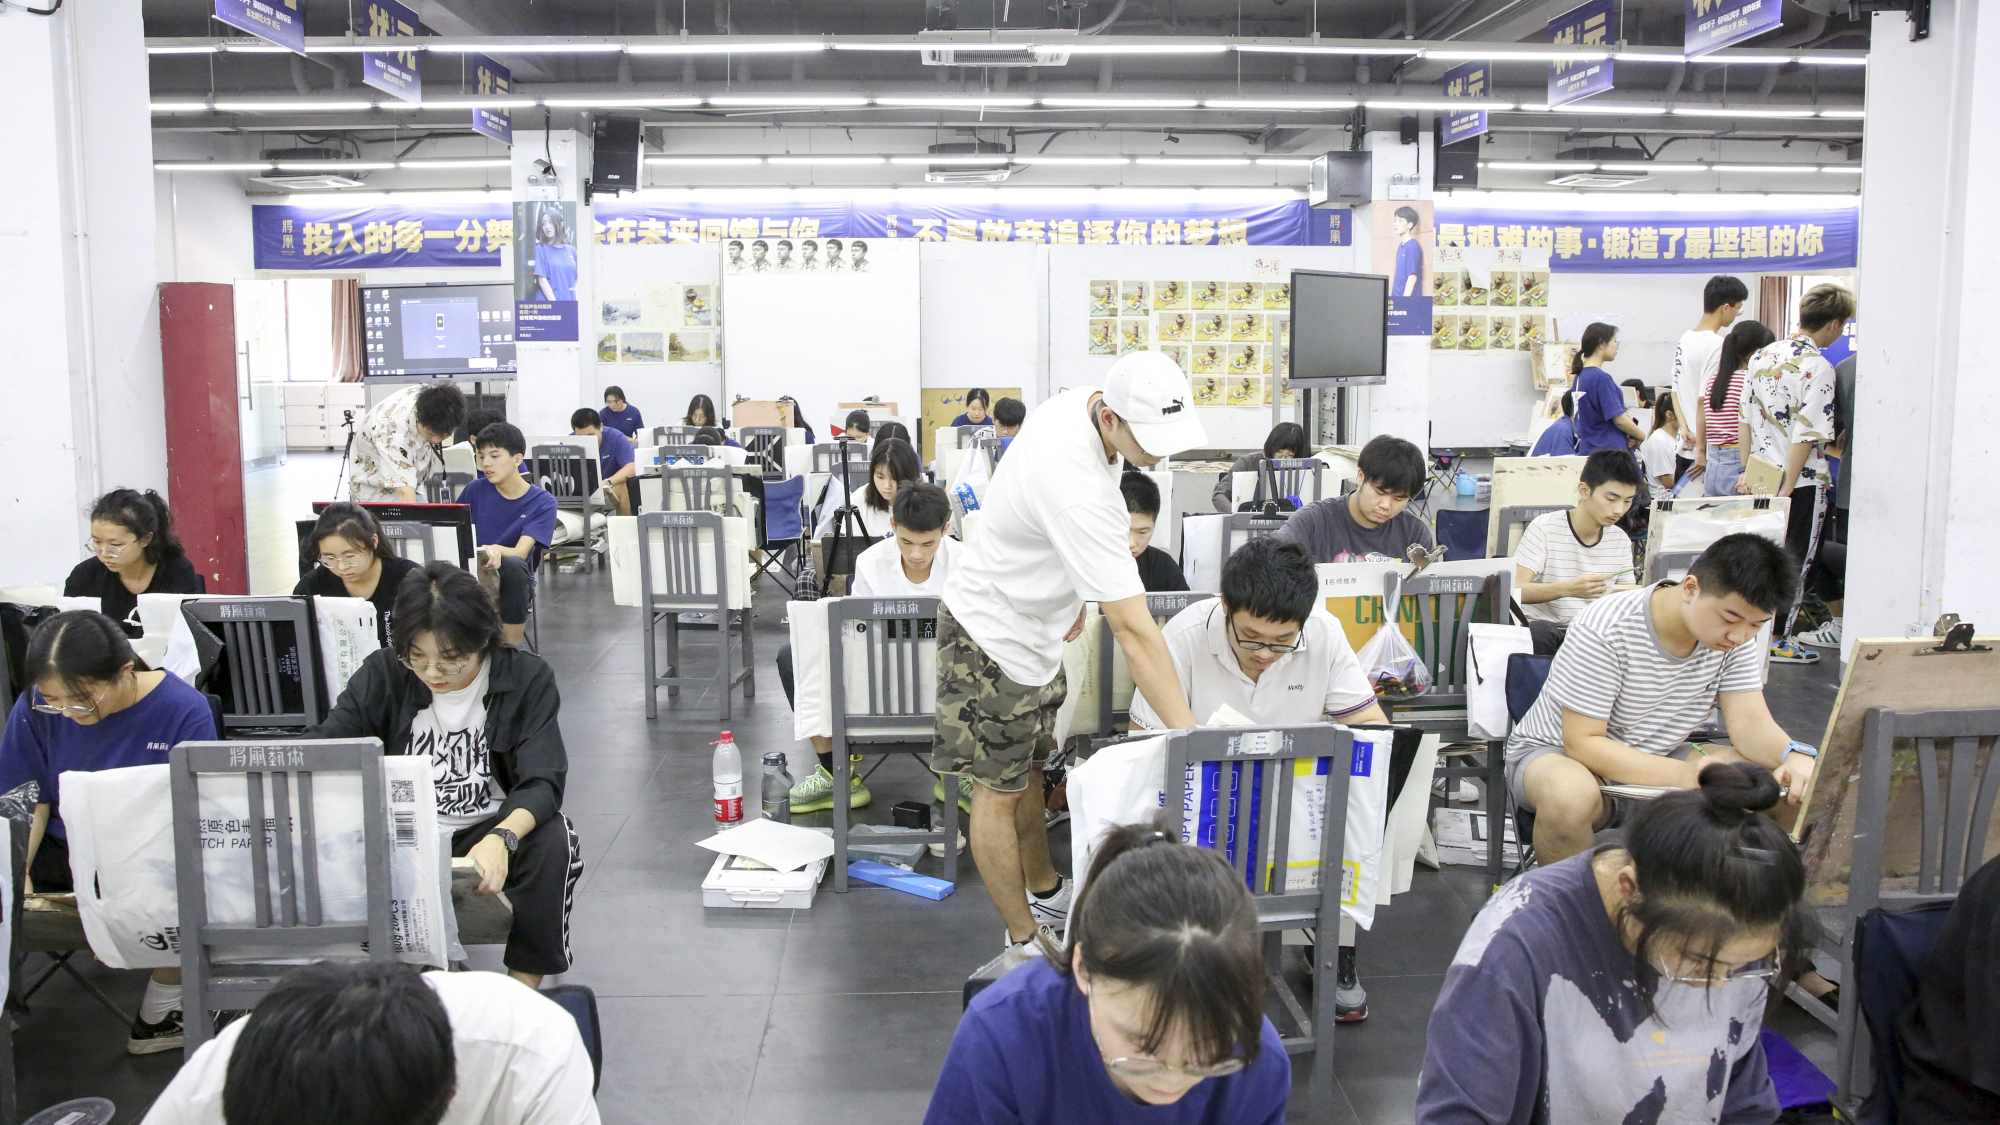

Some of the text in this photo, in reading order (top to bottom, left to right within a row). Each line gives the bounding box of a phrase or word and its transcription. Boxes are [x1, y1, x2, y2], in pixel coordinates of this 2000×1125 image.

[302, 218, 514, 256] 投入的每一分努
[1161, 404, 1182, 416] PUMA
[1328, 577, 1357, 586] 名师推荐
[1287, 683, 1305, 692] Mostly
[1183, 761, 1195, 812] PAPER
